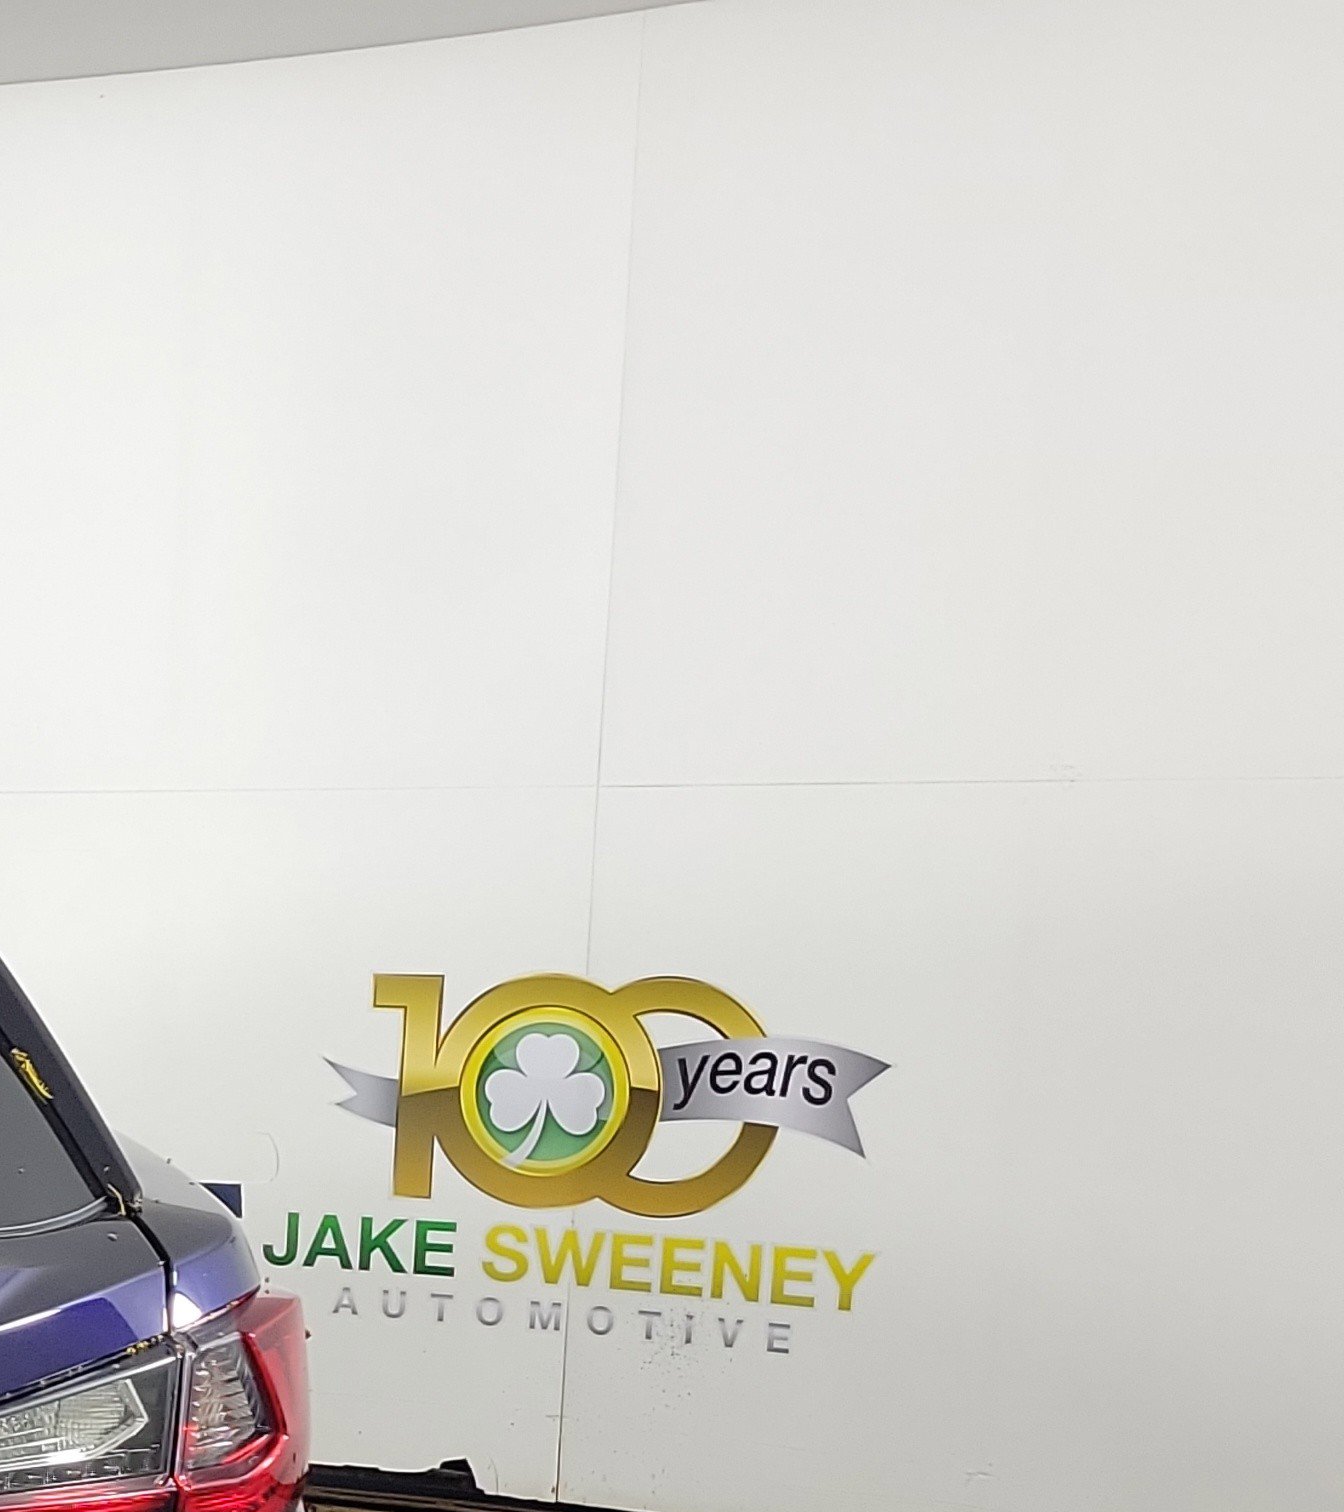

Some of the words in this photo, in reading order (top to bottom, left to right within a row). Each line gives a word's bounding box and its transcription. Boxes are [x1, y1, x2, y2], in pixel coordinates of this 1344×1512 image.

[373, 972, 778, 1216] 100
[673, 1051, 837, 1110] years
[263, 1212, 456, 1276] JAKE
[482, 1224, 876, 1311] SWEENEY
[333, 1287, 792, 1354] AUTOMOTIVE
